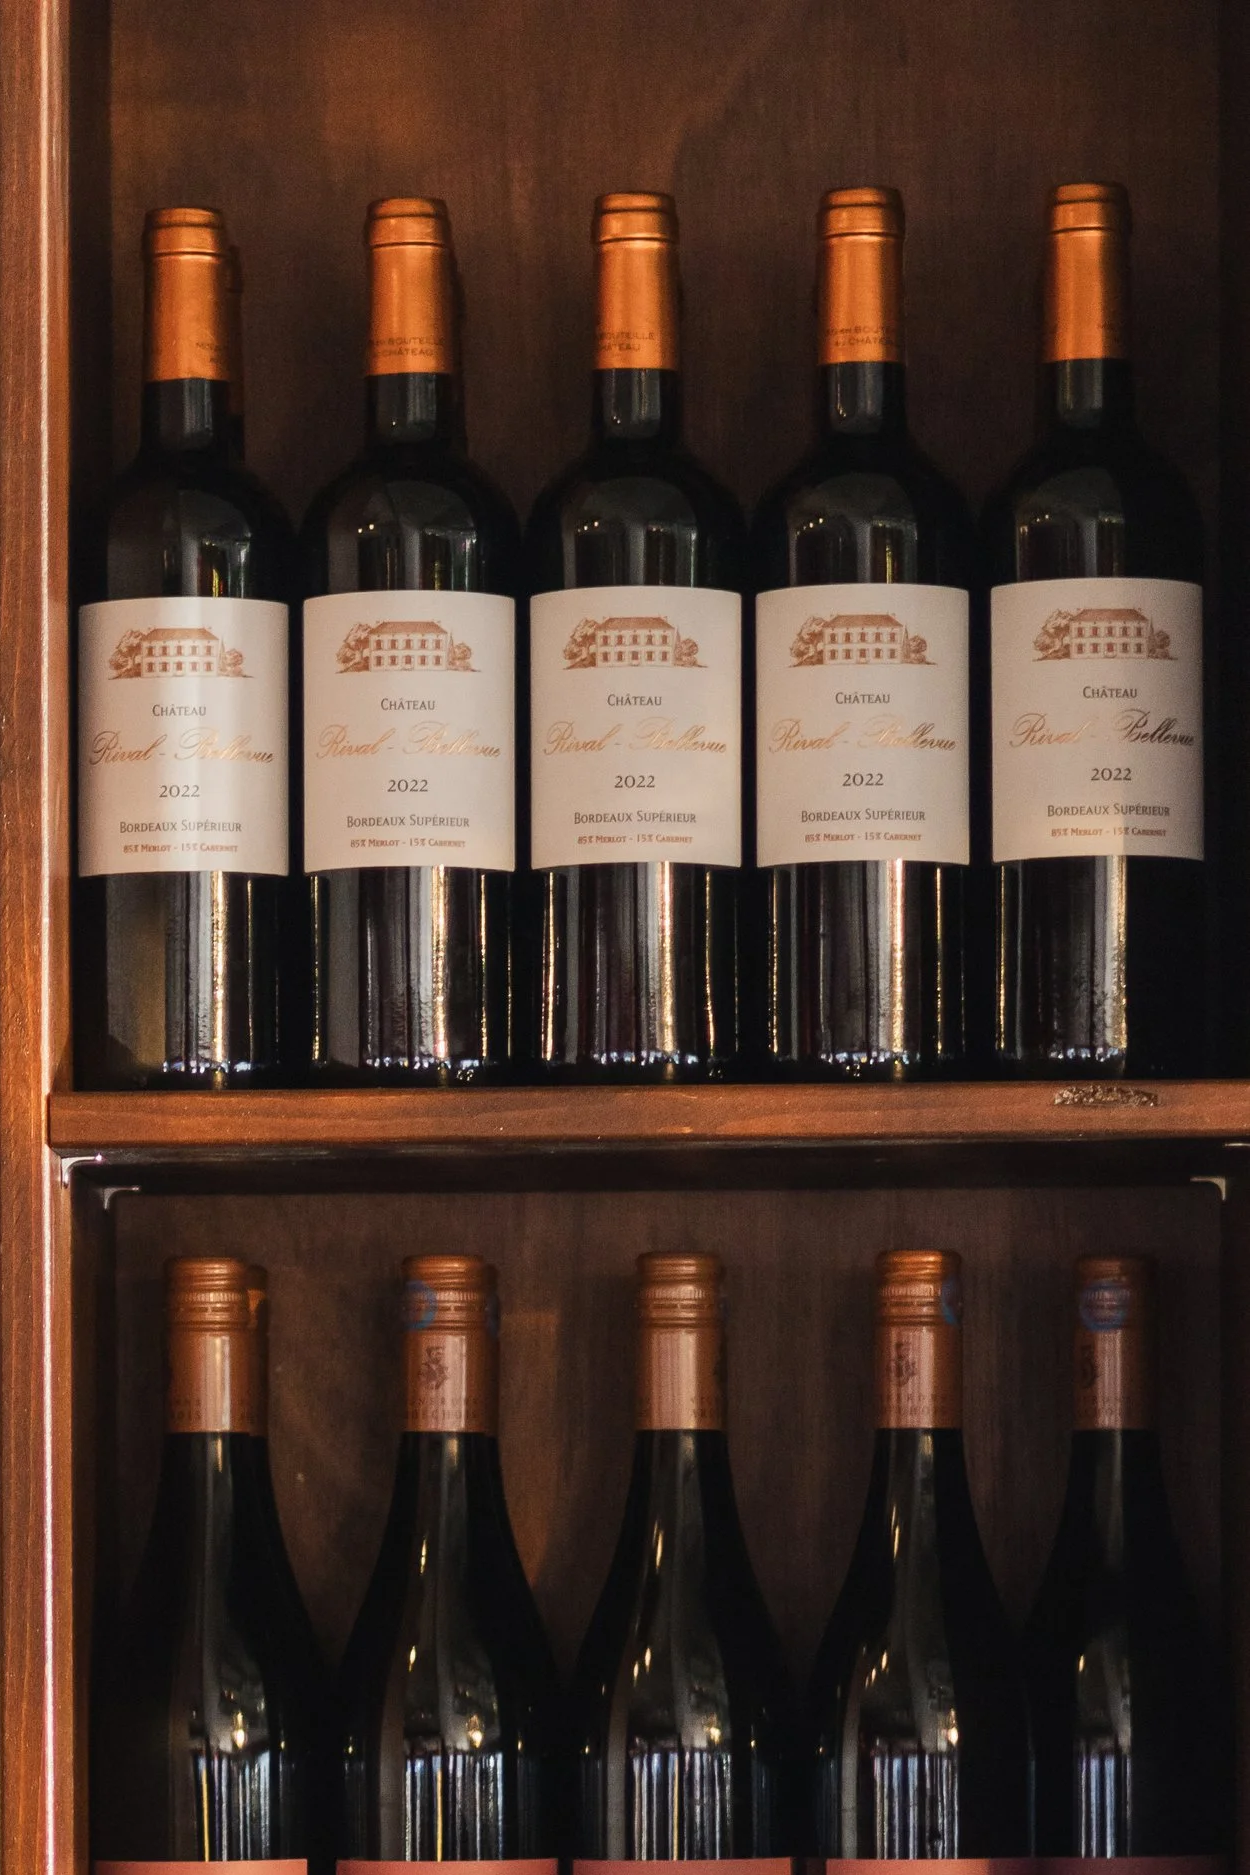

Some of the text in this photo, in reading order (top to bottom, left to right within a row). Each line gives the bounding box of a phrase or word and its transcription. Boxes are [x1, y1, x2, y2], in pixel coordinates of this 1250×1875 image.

[835, 692, 890, 704] CHÂTEAU
[1083, 686, 1137, 698] CHÂTEAU
[381, 698, 435, 711] CHÂTEAU
[607, 694, 662, 706] CHÂTEAU
[152, 704, 206, 716] CHÂTEAU
[842, 774, 884, 786] 2022
[1091, 768, 1132, 781] 2022
[387, 780, 428, 792] 2022
[614, 775, 655, 788] 2022
[159, 785, 200, 798] 2022
[801, 808, 926, 822] BORDEAUX SUPÉRIEUR
[1048, 803, 1170, 817] BORDEAUX SUPÉRIEUR
[347, 814, 470, 827] BORDEAUX SUPÉRIEUR
[574, 810, 696, 824] BORDEAUX SUPÉRIEUR
[120, 819, 242, 832] BORDEAUX SUPÉRIEUR
[368, 839, 400, 847] MERLOT
